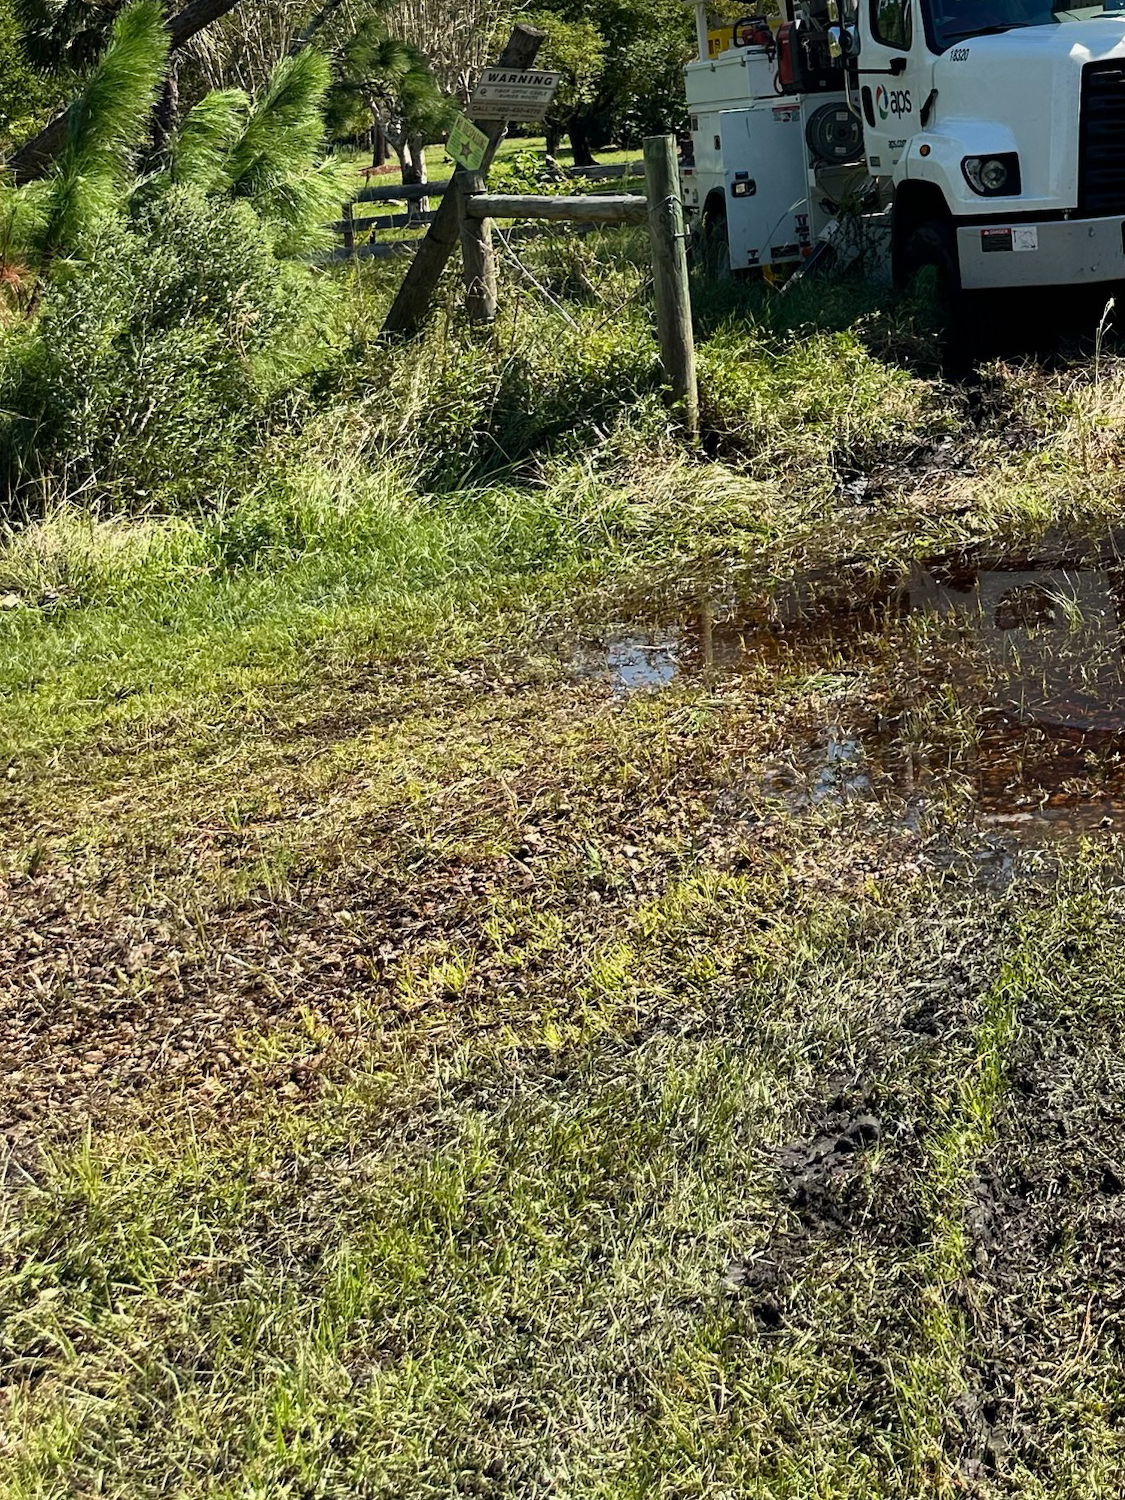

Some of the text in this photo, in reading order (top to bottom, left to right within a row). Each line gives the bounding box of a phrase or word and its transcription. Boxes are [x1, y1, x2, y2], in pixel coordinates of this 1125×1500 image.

[949, 48, 970, 62] 18320
[488, 73, 553, 85] WARNING
[890, 90, 912, 120] aps
